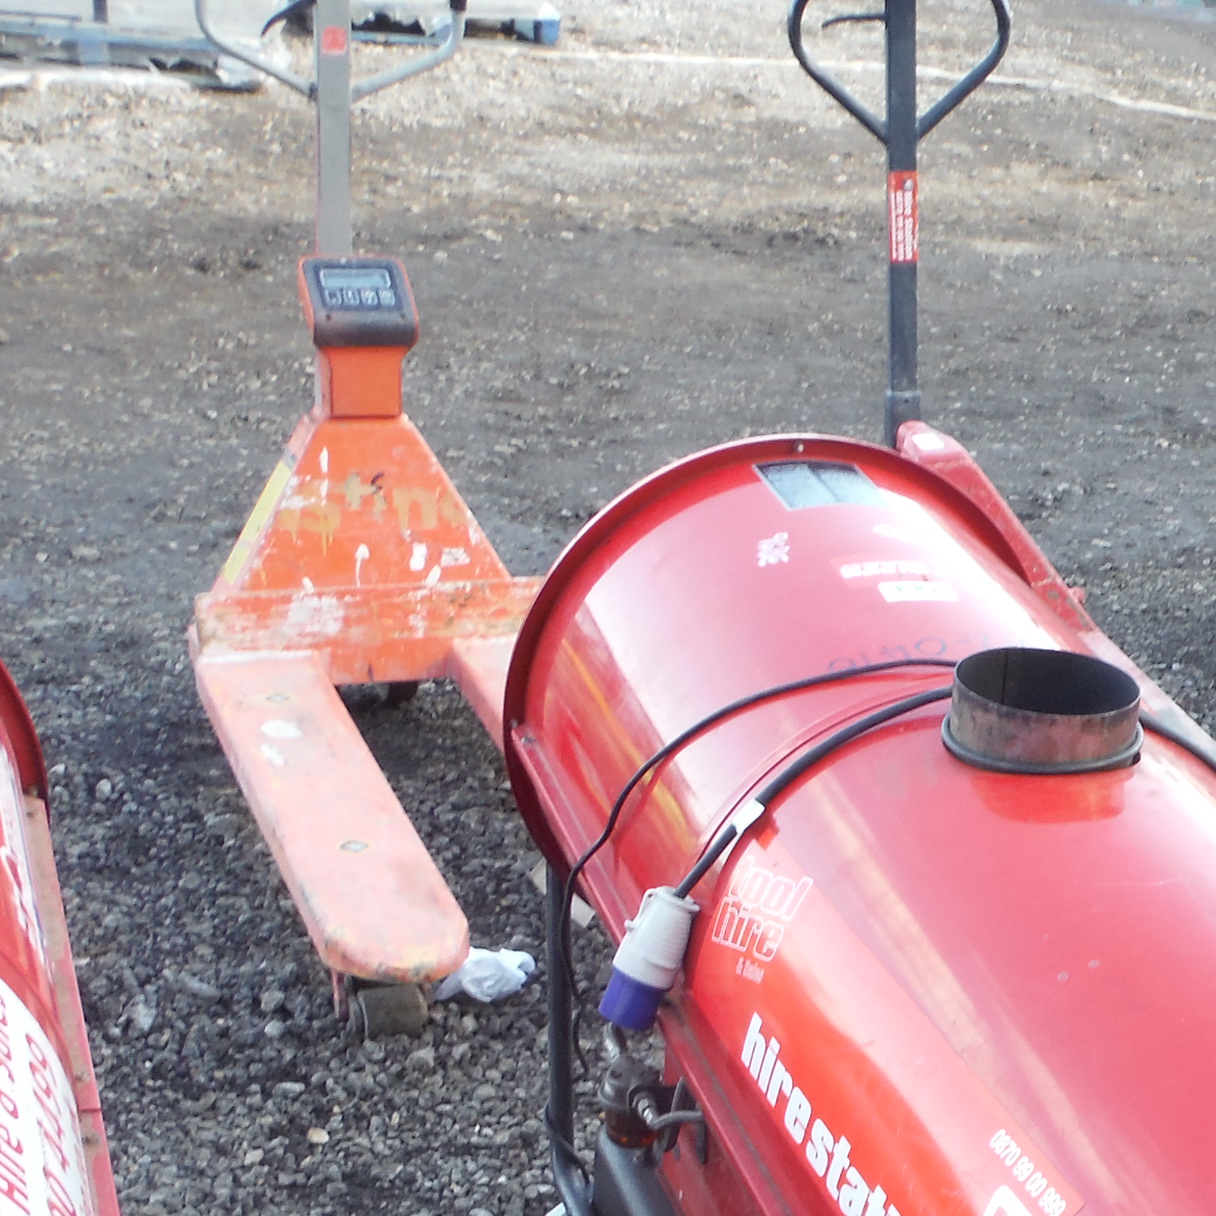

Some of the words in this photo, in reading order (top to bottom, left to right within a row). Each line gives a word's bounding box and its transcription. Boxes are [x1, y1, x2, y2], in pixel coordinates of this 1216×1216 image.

[729, 855, 814, 921] tool
[712, 896, 785, 962] hire
[25, 1031, 70, 1176] 4499
[989, 1129, 1022, 1167] 0870
[1012, 1156, 1034, 1182] 99
[1025, 1171, 1048, 1198] 00
